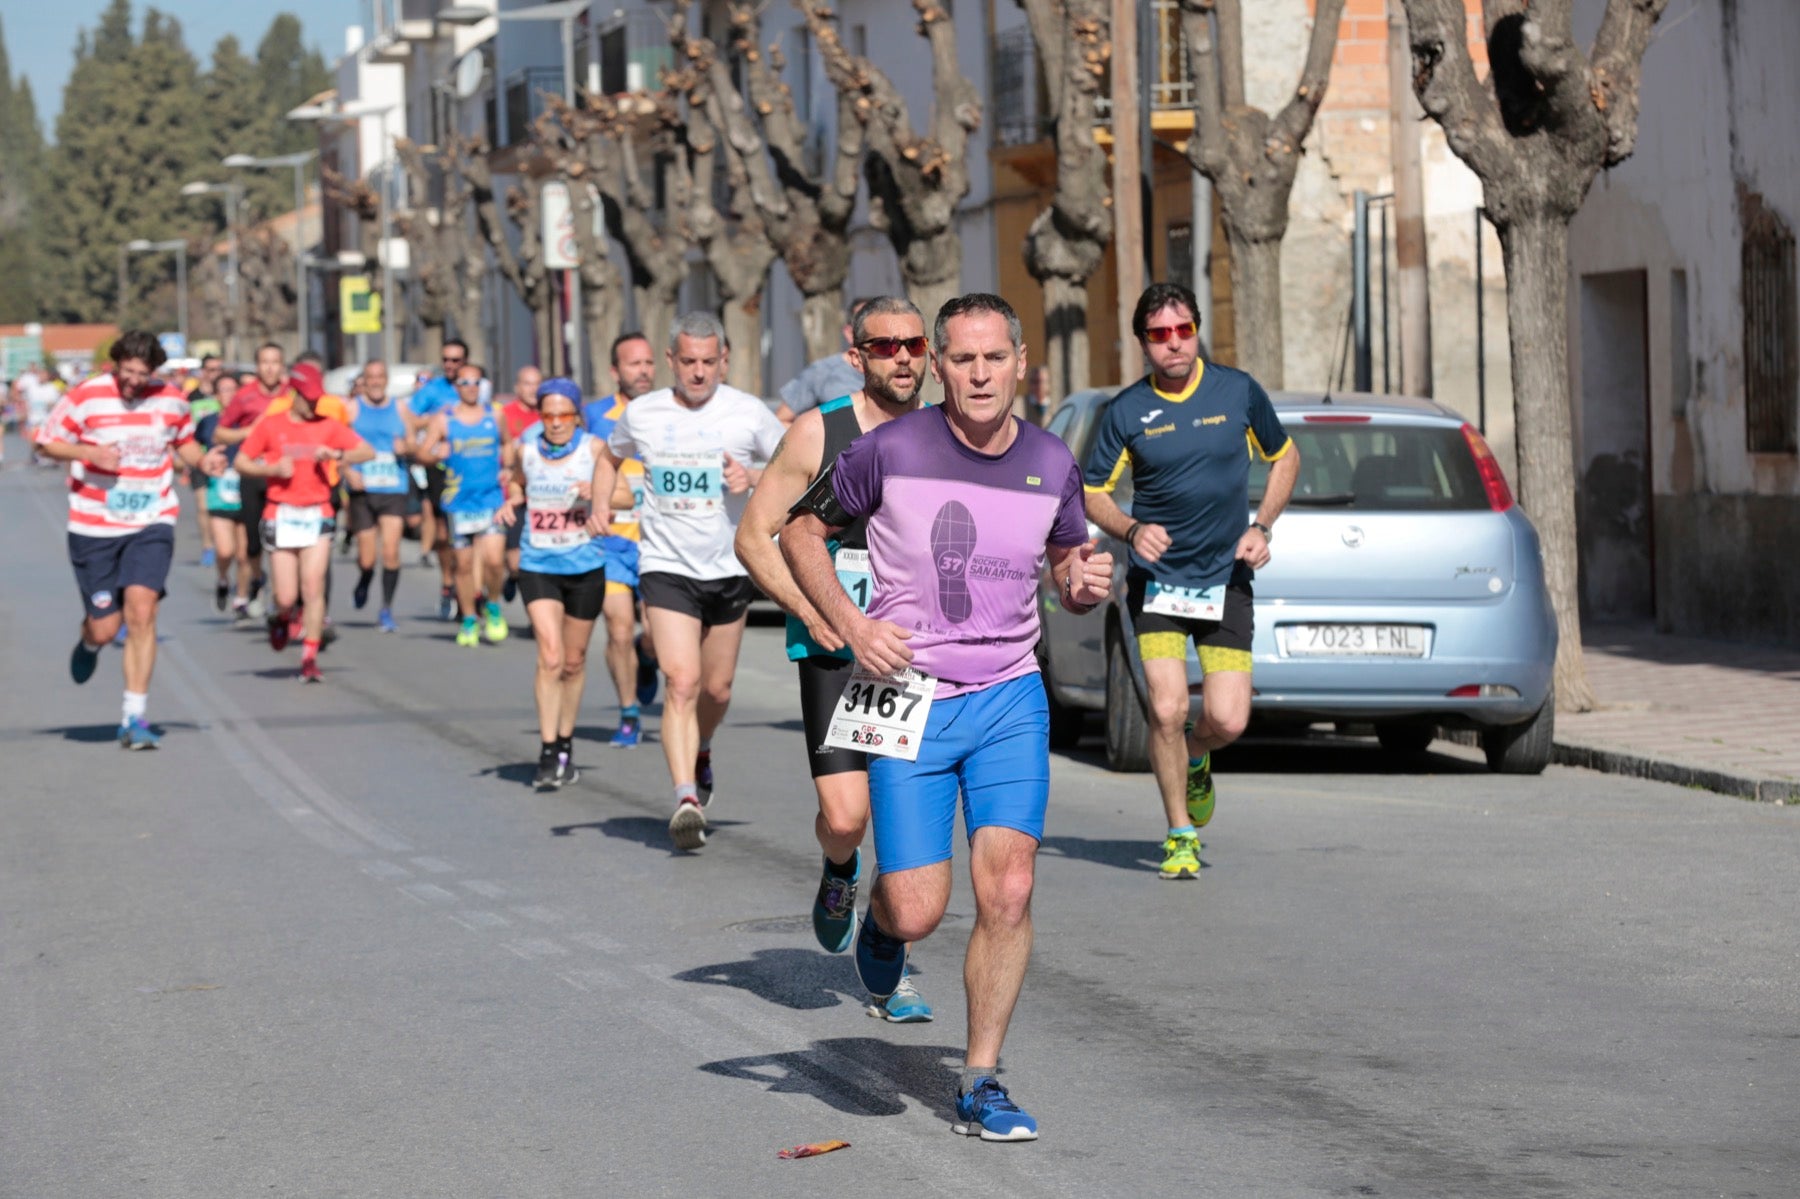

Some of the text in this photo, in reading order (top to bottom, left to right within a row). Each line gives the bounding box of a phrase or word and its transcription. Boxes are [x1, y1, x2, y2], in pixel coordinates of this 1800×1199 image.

[663, 471, 709, 493] 894
[115, 492, 151, 510] 367
[533, 510, 587, 531] 2276
[940, 557, 962, 571] 37
[969, 564, 992, 577] SAN
[972, 557, 1010, 569] NOCHE DE
[1308, 625, 1417, 649] 7023 FNL
[844, 682, 923, 722] 3167
